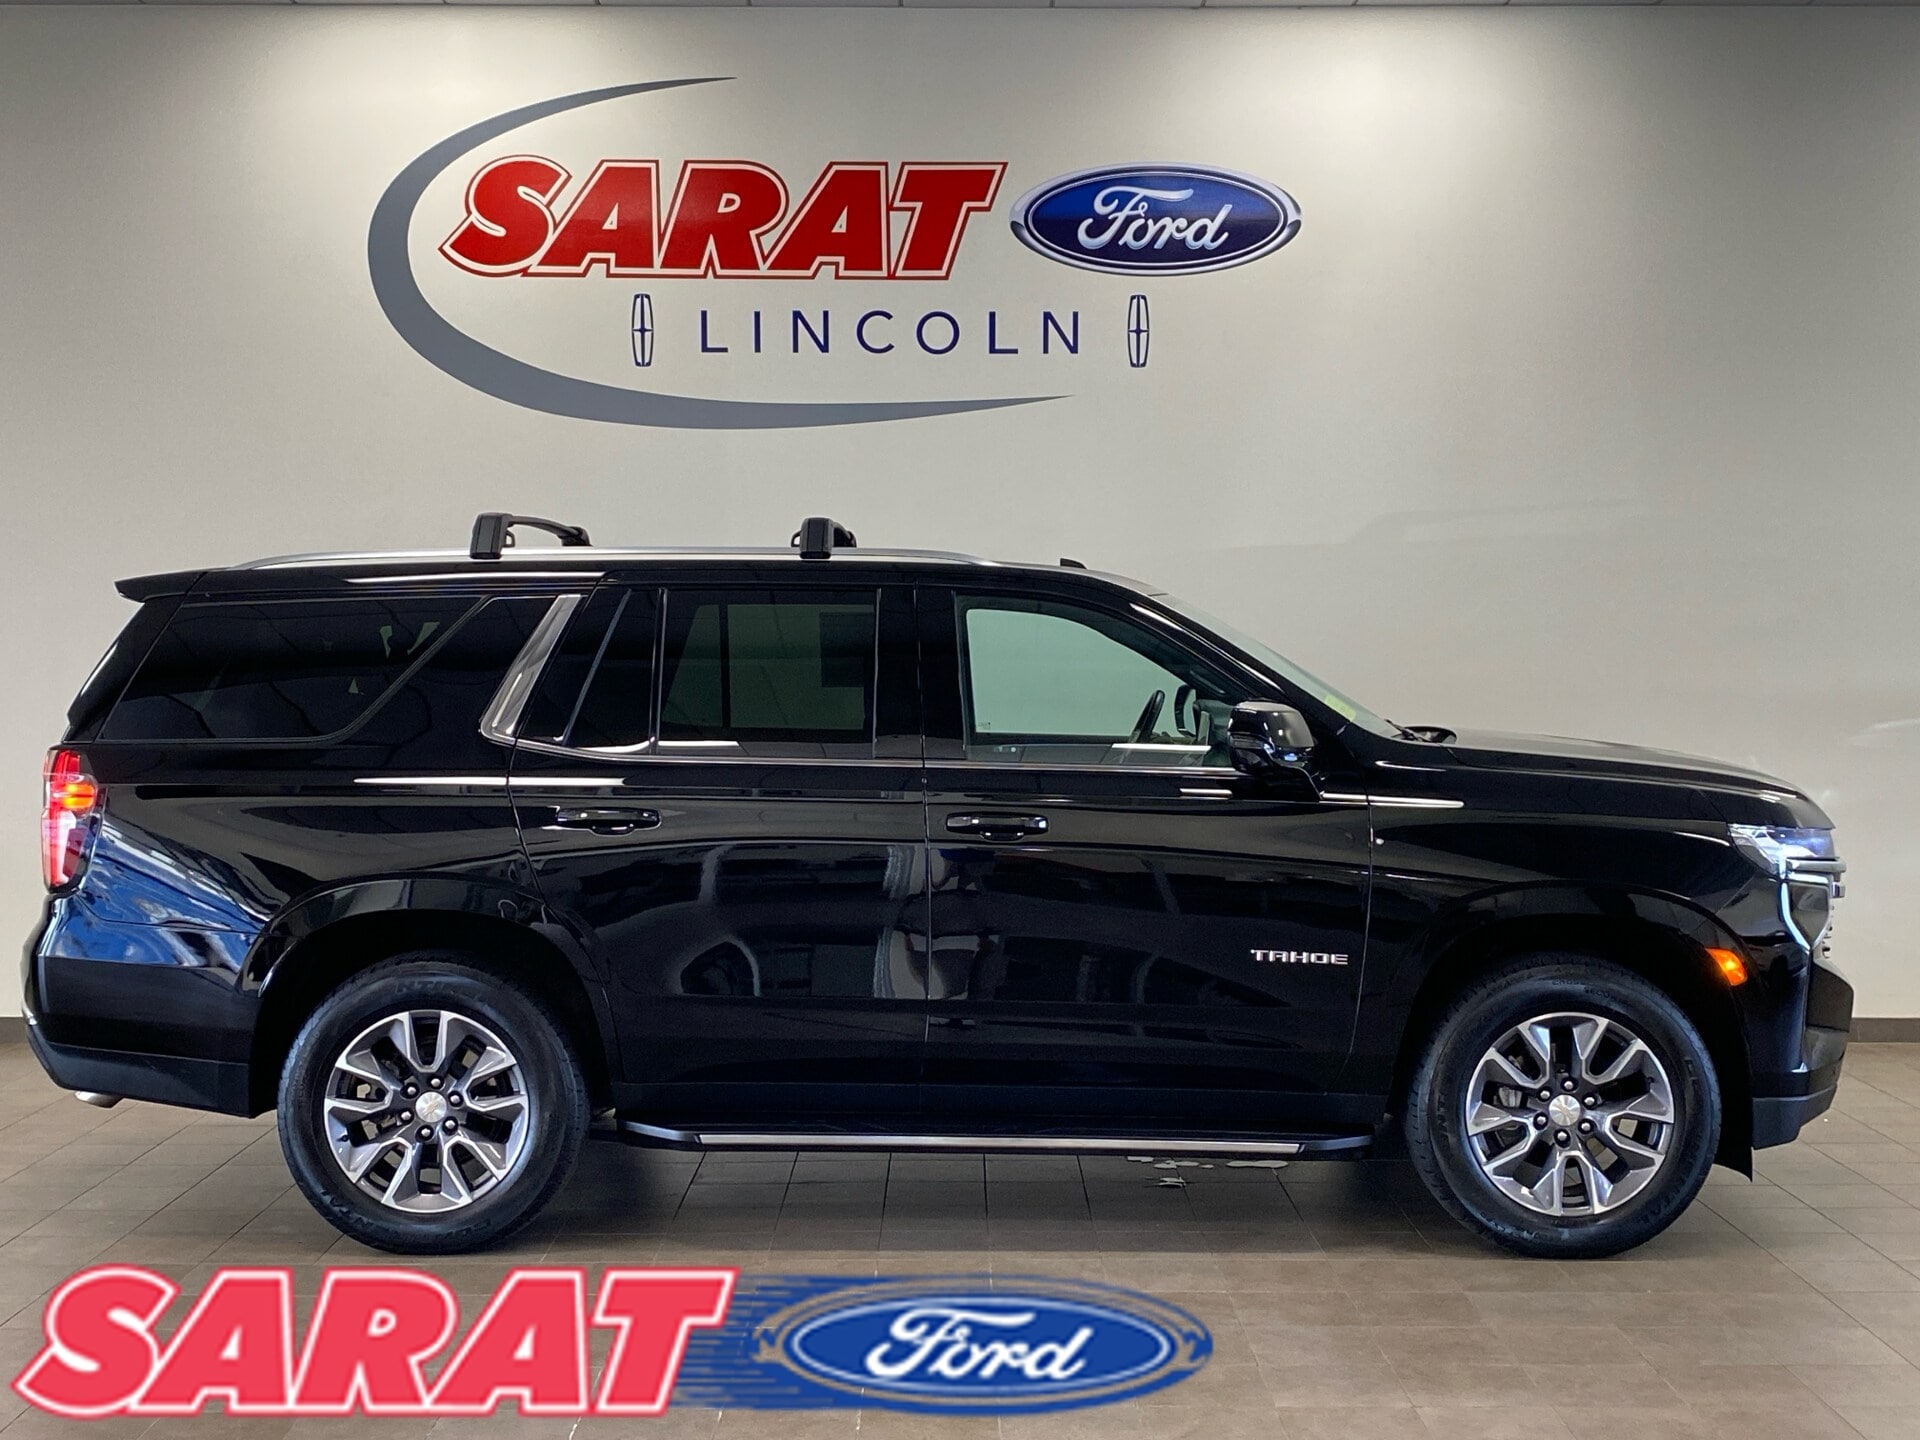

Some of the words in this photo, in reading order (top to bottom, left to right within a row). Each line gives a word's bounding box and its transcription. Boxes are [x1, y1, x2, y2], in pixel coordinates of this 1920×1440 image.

[440, 155, 1008, 280] SARAT
[1077, 185, 1232, 250] Ford
[700, 309, 1079, 355] LINCOLN
[1250, 949, 1349, 965] TAHOE
